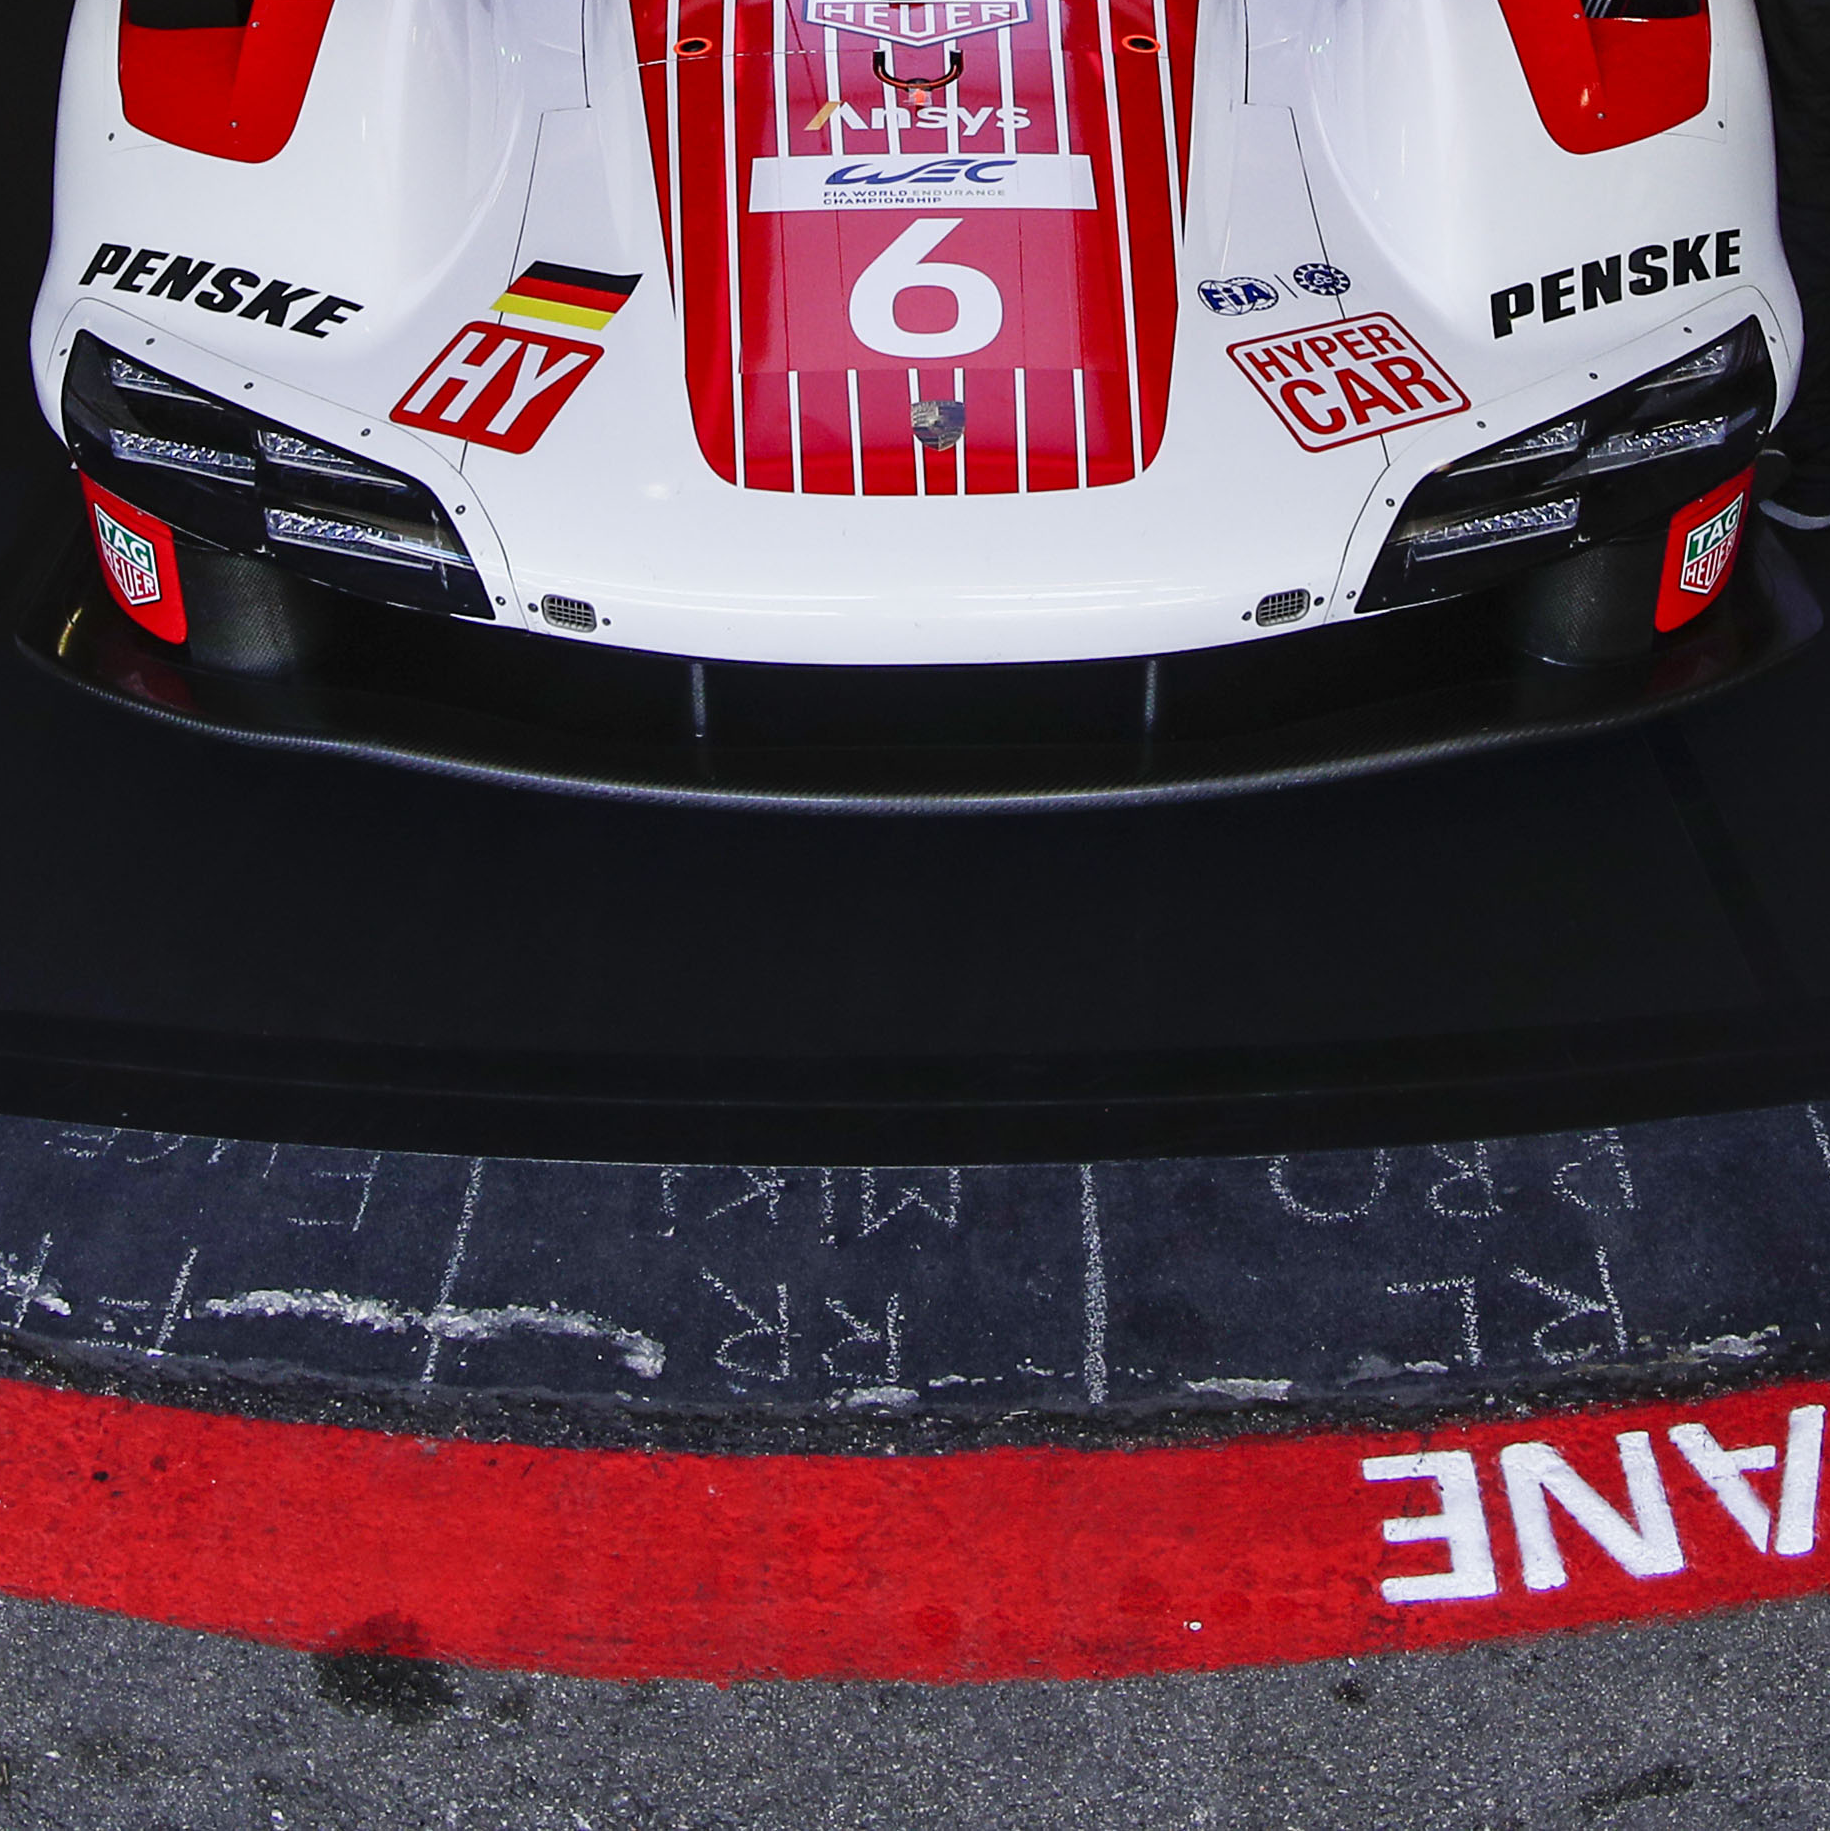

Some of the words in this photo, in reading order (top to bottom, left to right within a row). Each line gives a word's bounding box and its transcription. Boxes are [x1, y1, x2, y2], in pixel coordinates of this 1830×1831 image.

[823, 3, 1011, 38] HEUER
[804, 101, 1032, 136] Ansys
[825, 159, 1017, 185] WEC
[852, 189, 907, 197] WORLD
[823, 197, 942, 205] CHAMPIONSHIP
[79, 242, 364, 338] PENSKE
[849, 217, 1004, 358] 6
[1490, 229, 1741, 339] PENSKE
[1244, 324, 1407, 382] HYPER
[402, 330, 593, 438] HY
[1280, 356, 1453, 435] CAR
[98, 514, 150, 569] TAG
[1692, 504, 1738, 555] TAG
[102, 541, 155, 598] HEUER
[701, 1267, 902, 1383] RR
